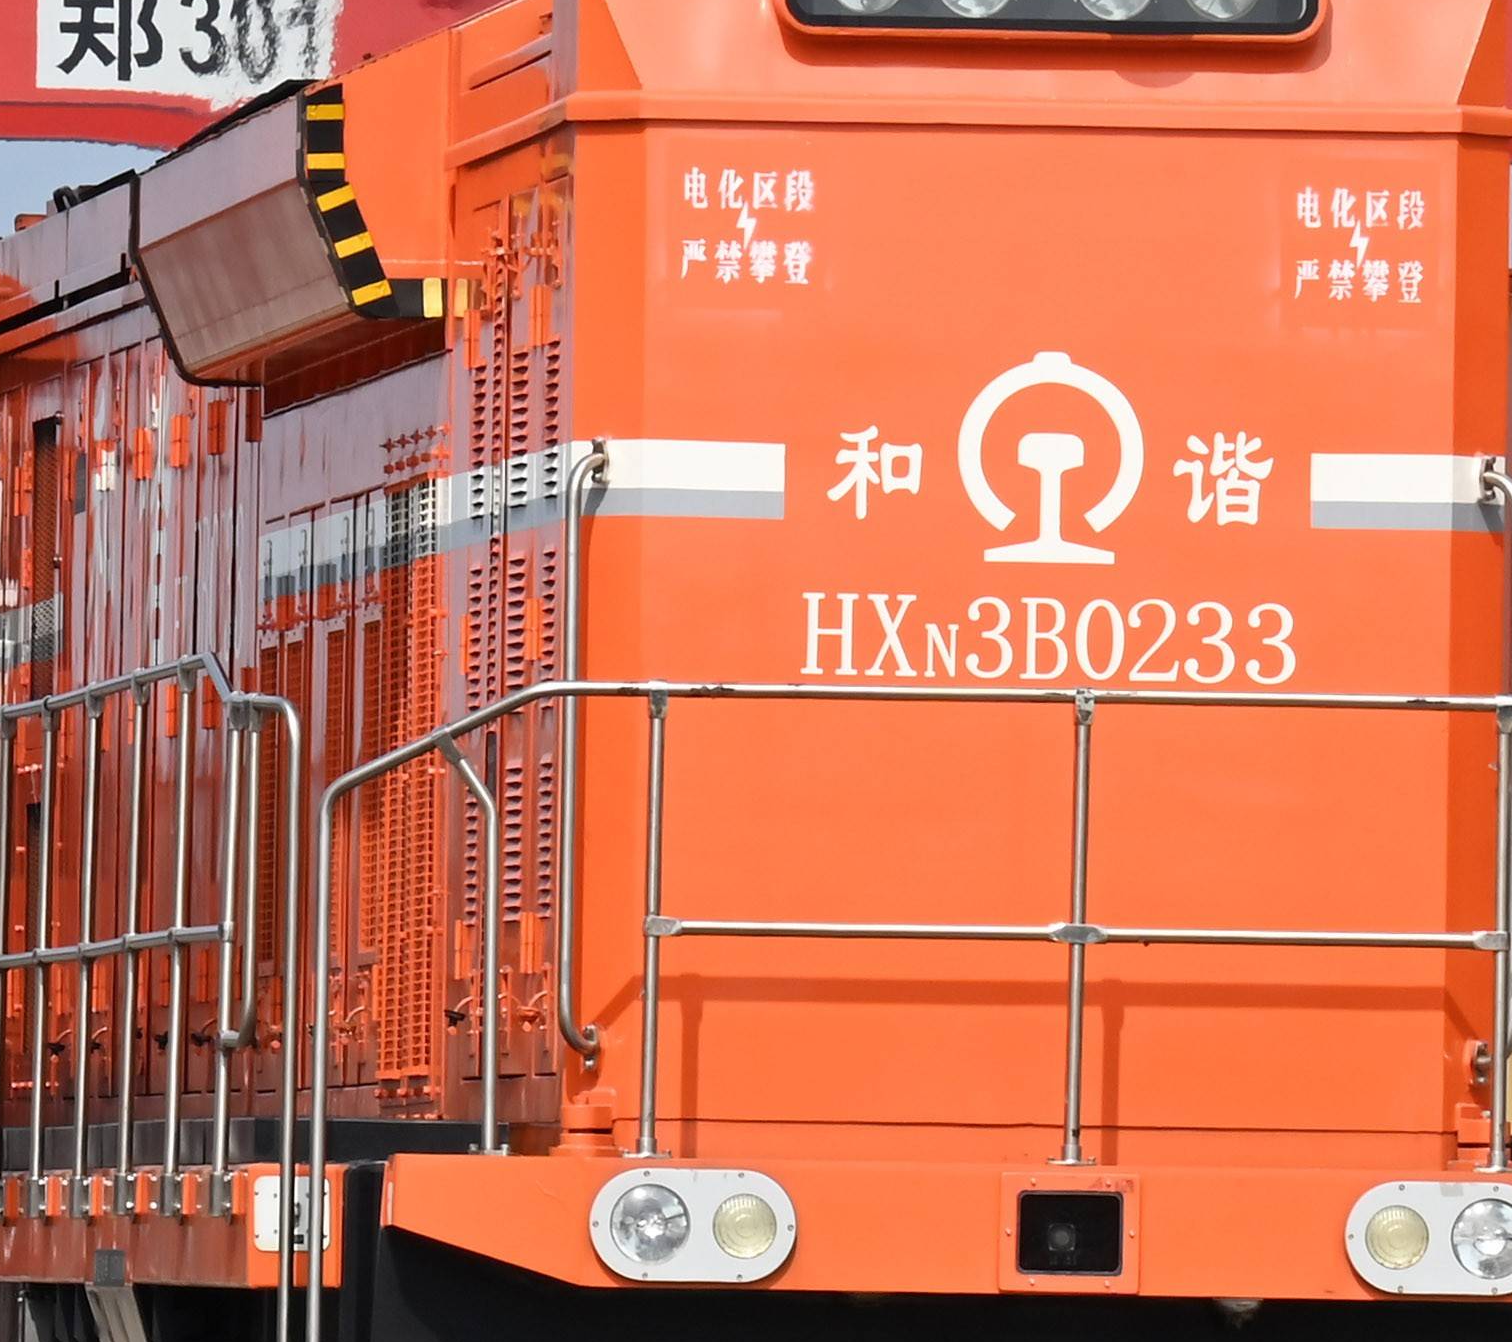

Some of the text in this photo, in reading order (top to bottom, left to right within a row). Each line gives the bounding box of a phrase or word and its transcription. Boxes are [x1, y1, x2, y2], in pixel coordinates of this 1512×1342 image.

[681, 166, 815, 213] 电化区段
[1294, 188, 1425, 230] 电化区段
[680, 240, 811, 285] 严禁攀登
[1294, 260, 1423, 304] 严禁攀登
[827, 426, 1274, 527] 和 谐
